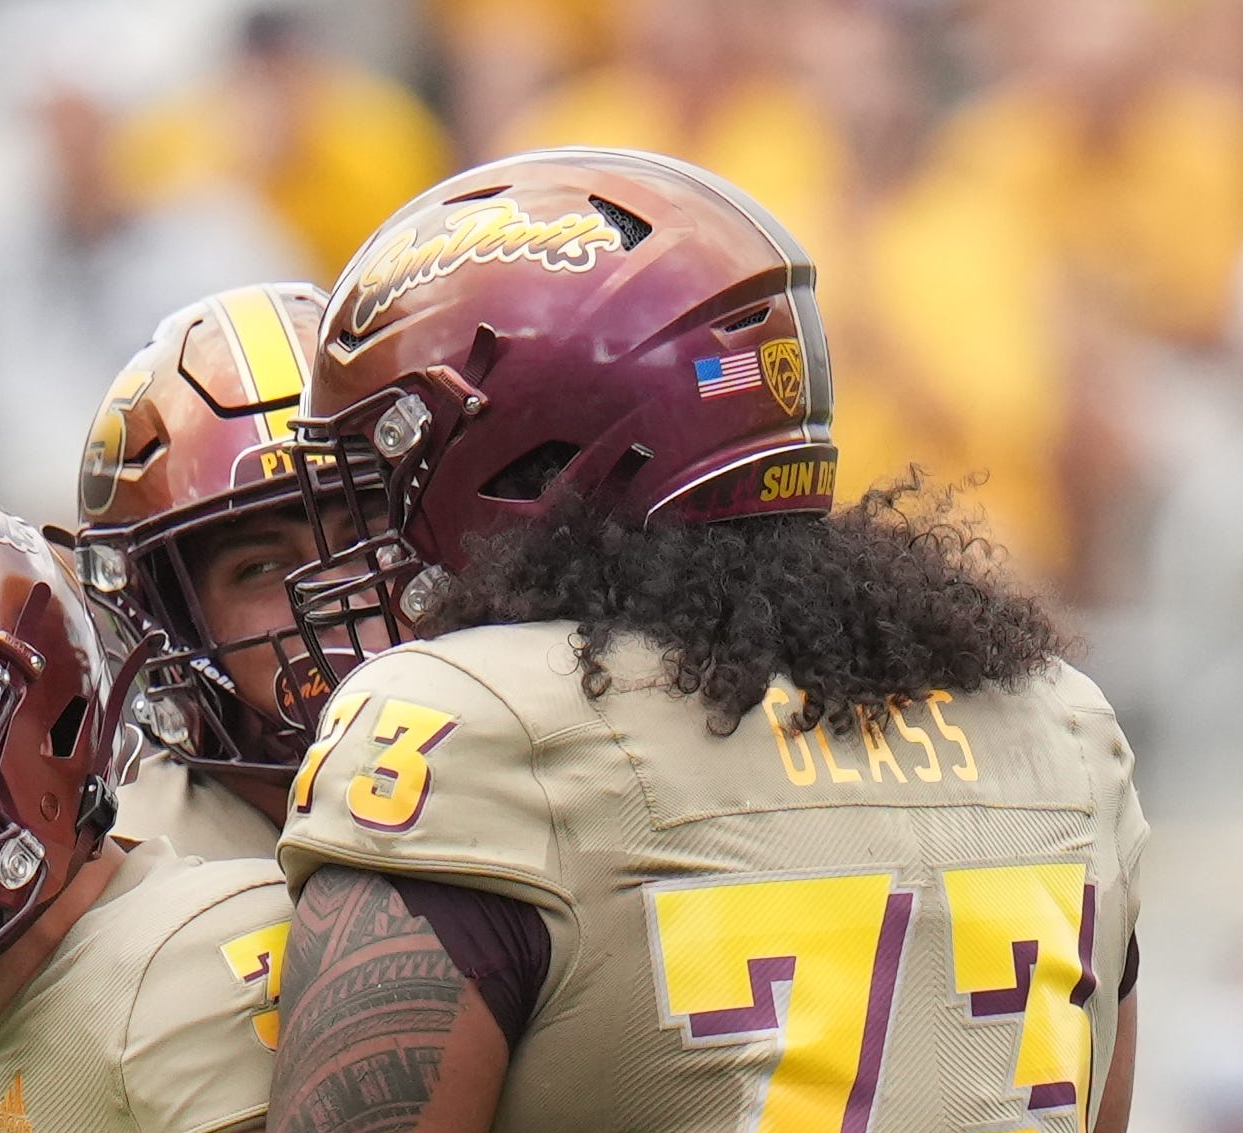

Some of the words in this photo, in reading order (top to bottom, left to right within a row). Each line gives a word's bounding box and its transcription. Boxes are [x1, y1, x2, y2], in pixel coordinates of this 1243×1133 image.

[759, 461, 815, 502] SUN
[293, 690, 460, 834] 73
[762, 686, 979, 787] GLASS
